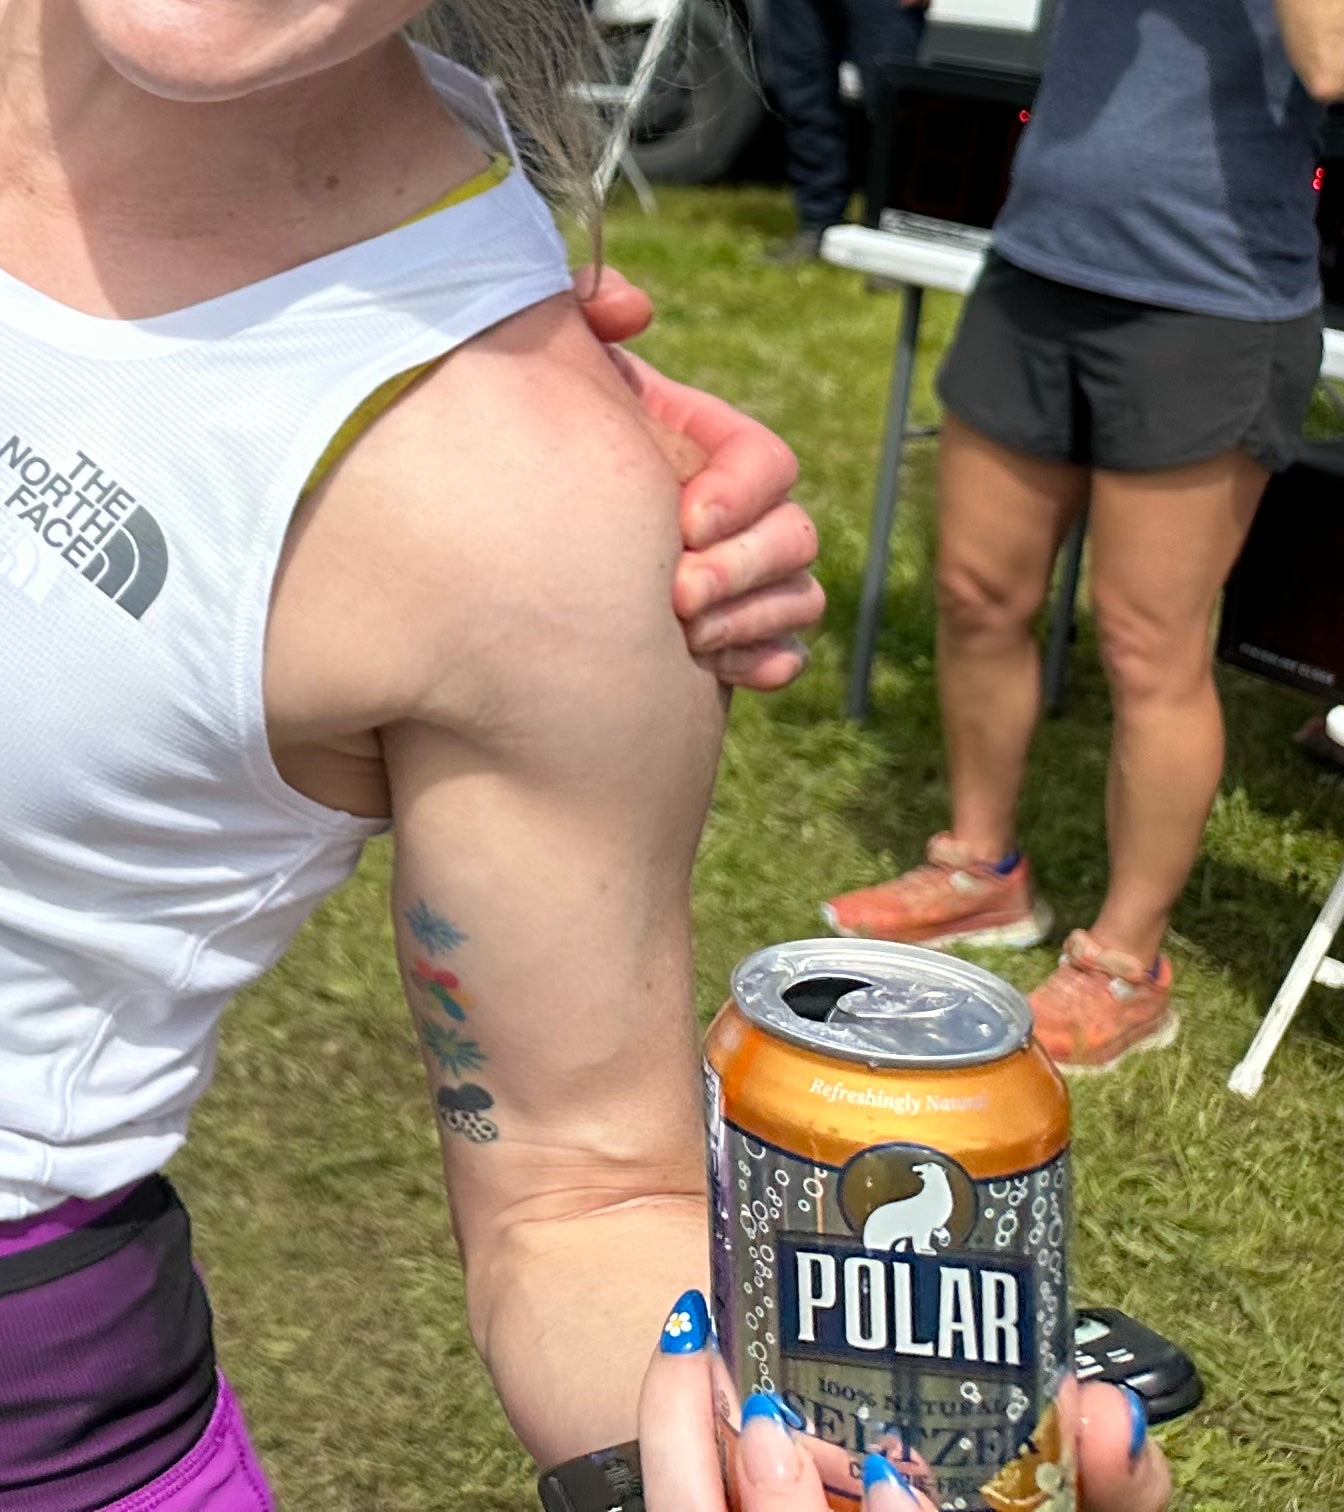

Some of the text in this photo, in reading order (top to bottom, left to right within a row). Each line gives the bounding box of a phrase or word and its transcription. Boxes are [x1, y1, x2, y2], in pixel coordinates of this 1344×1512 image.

[69, 450, 136, 522] THE
[4, 483, 95, 569] FACE
[808, 1076, 922, 1116] Refreshingly
[795, 1250, 1022, 1367] POLAR
